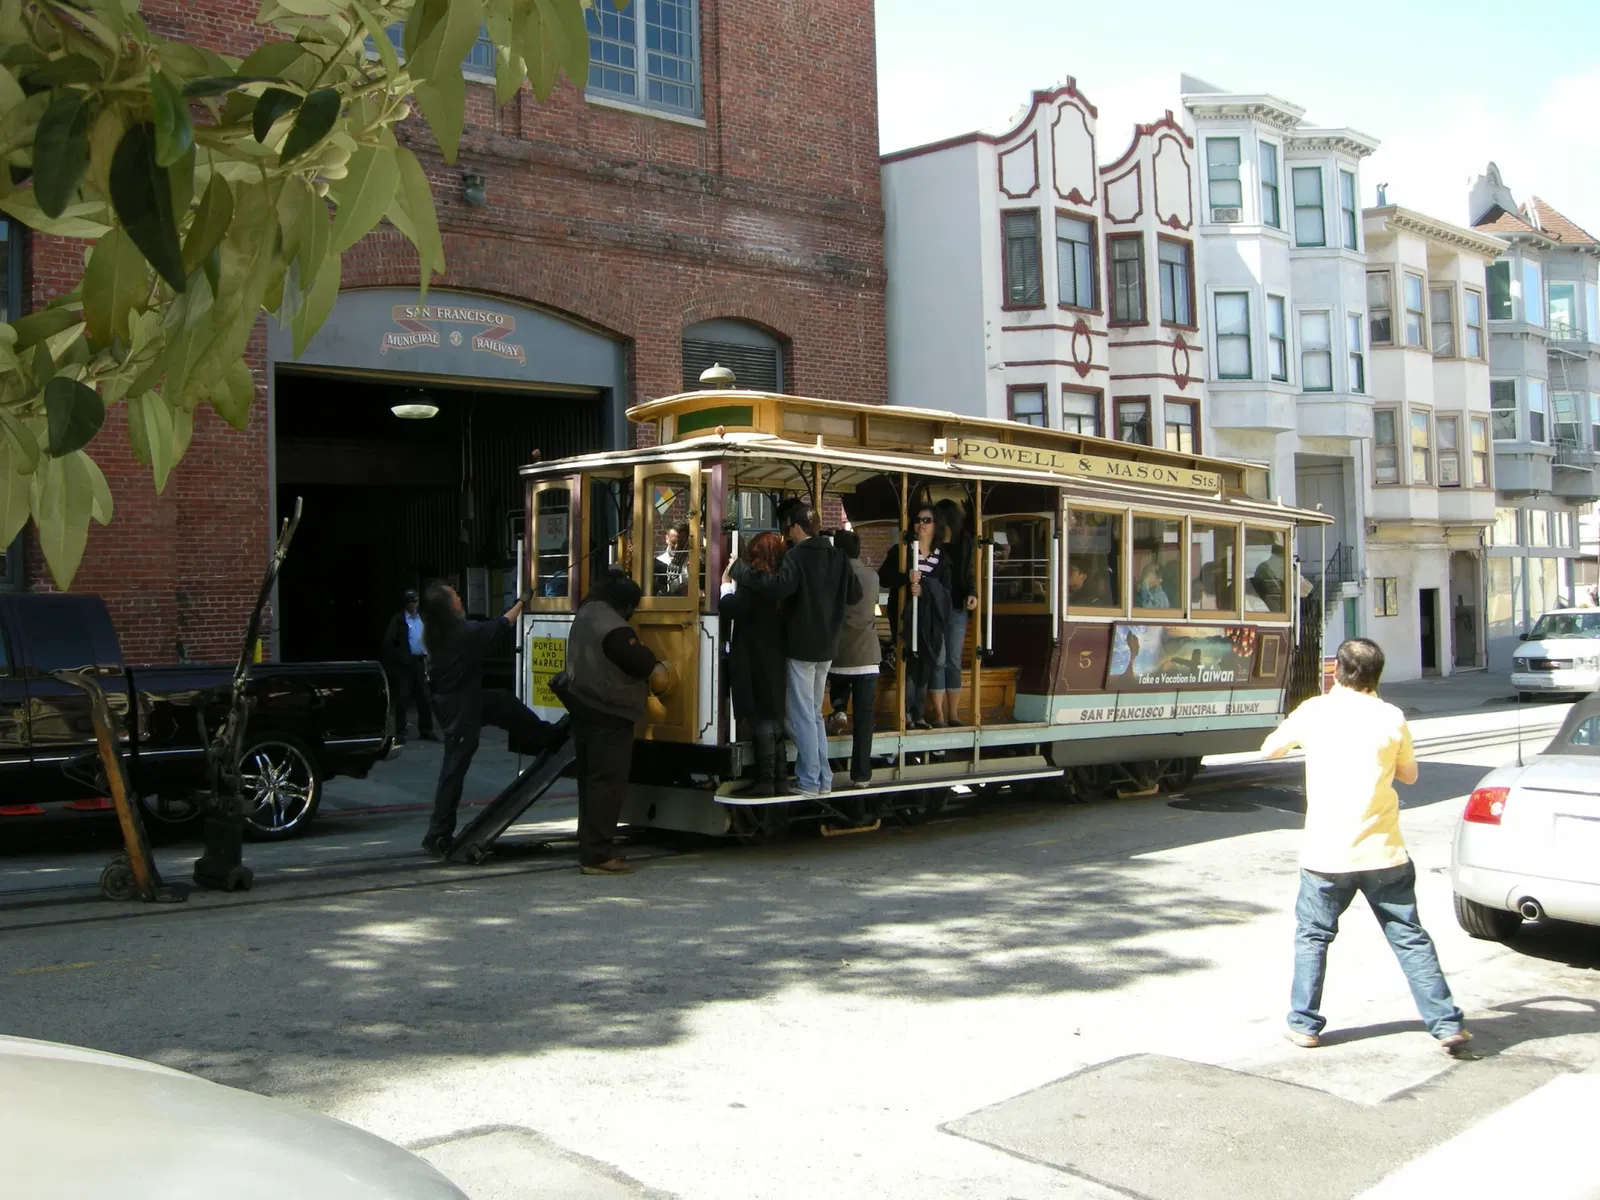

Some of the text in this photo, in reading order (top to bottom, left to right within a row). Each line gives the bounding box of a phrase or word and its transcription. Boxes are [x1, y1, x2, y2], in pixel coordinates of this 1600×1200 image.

[405, 307, 504, 325] SAN FRANCISCO
[387, 333, 439, 346] MUNICIPAL
[476, 338, 519, 356] RAILWAY
[963, 442, 1218, 488] POWELL & MASON Sts.
[533, 642, 564, 651] POWELL
[532, 659, 564, 667] MARKET
[1078, 651, 1092, 669] 5
[1138, 673, 1154, 684] Take
[1161, 672, 1188, 683] Vacation
[1189, 672, 1197, 683] to
[1197, 664, 1234, 682] Taiwan
[1080, 709, 1103, 721] SAN
[1224, 702, 1260, 714] RAILWAY
